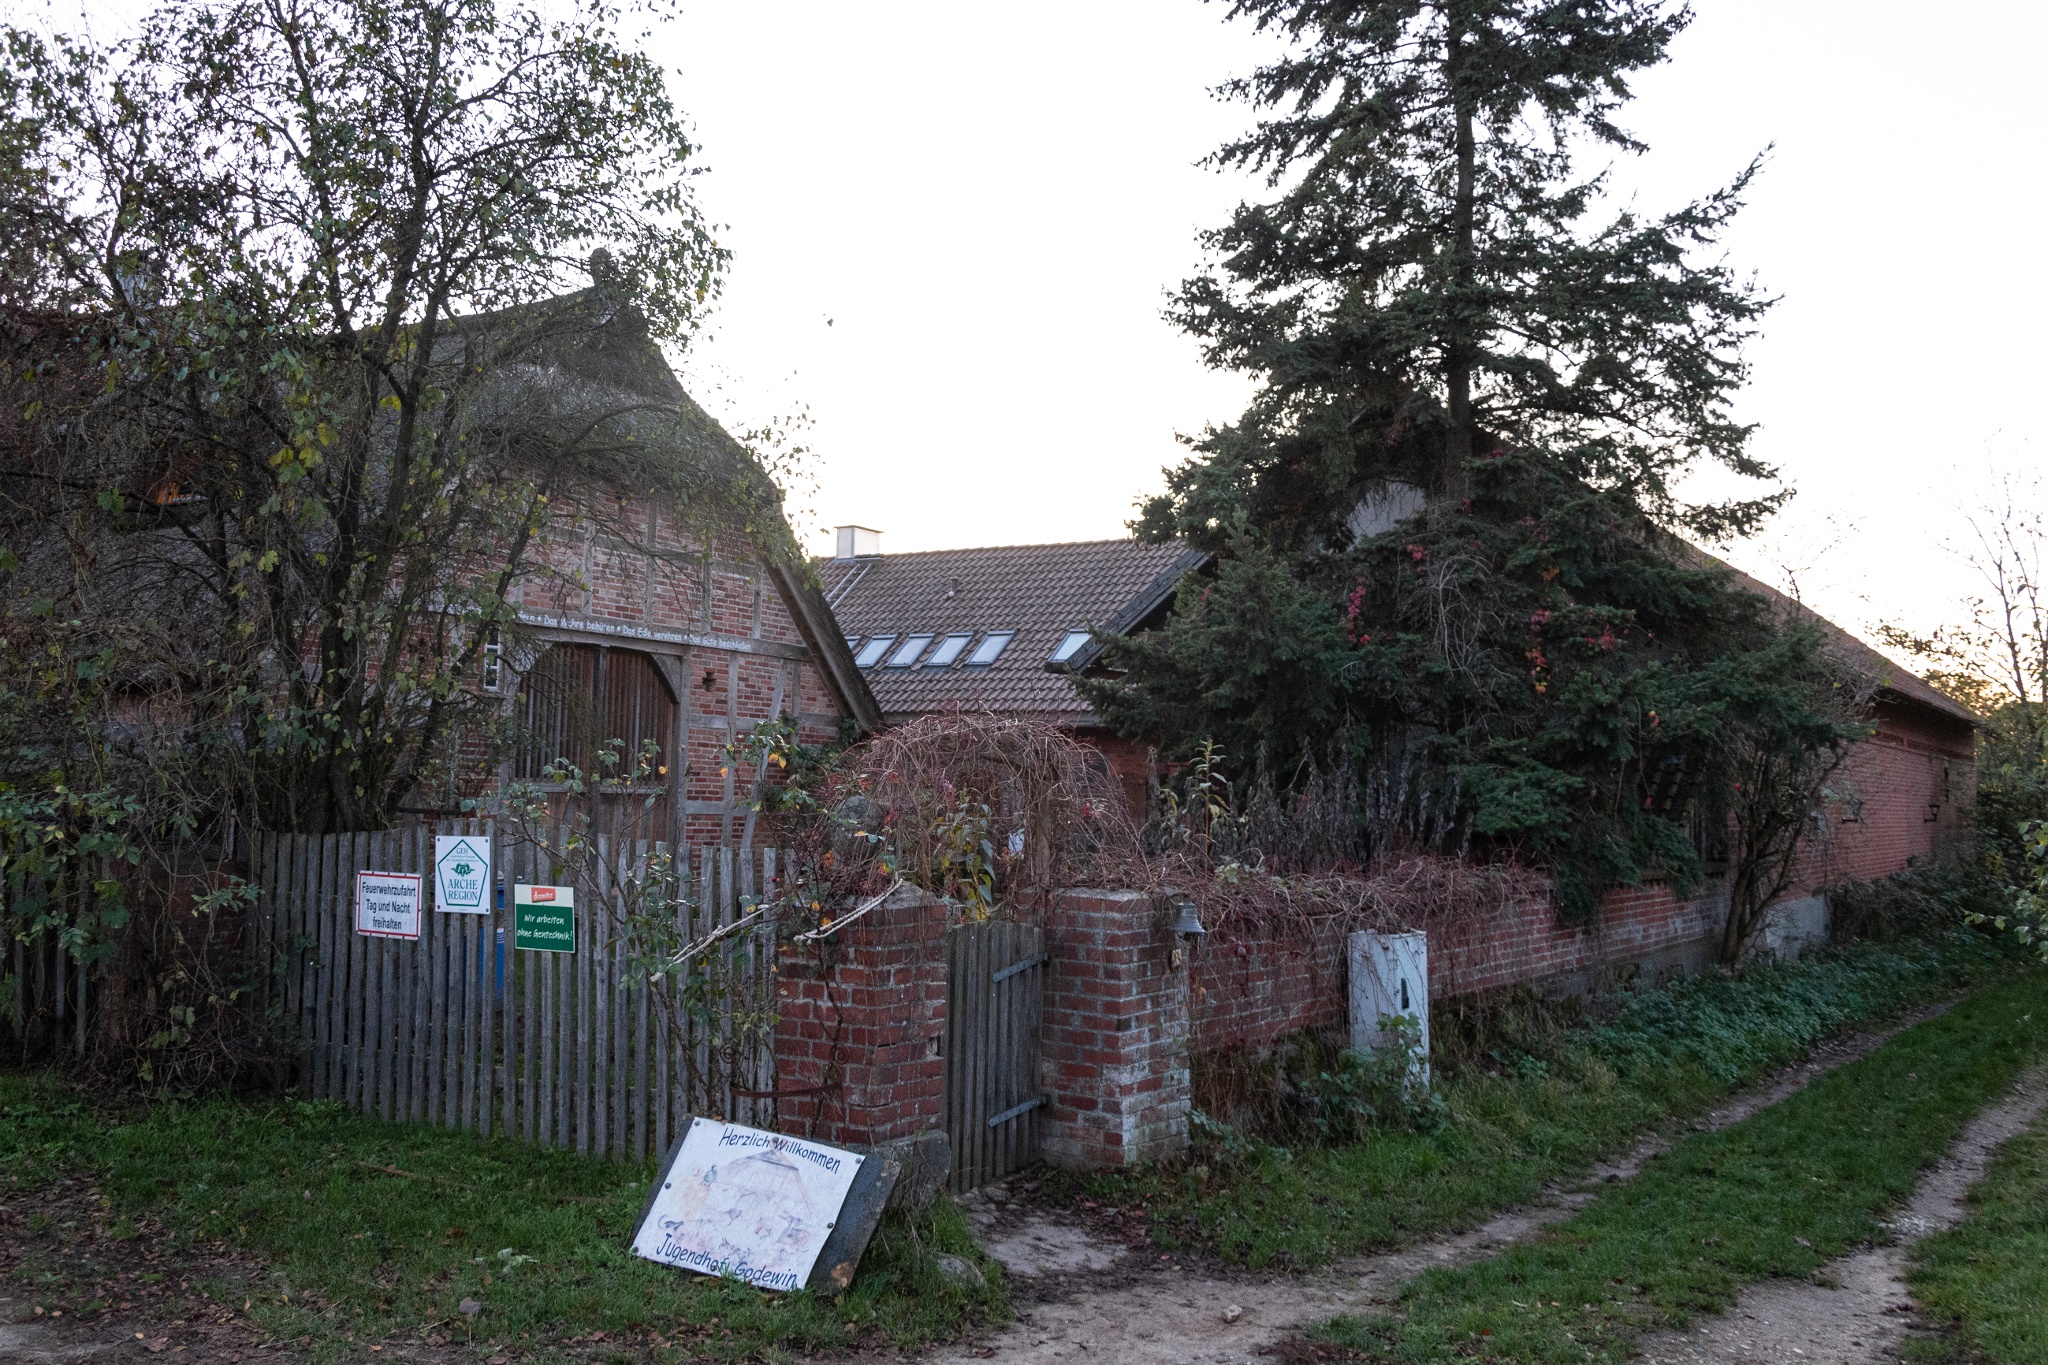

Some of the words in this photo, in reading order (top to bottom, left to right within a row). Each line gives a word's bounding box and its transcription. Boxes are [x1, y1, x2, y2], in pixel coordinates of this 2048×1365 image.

[544, 614, 558, 625] Das
[622, 625, 636, 635] Das
[637, 627, 652, 637] Edle
[362, 881, 416, 897] Feuerwehrzufahrt
[448, 890, 478, 901] REGION
[366, 899, 377, 913] Tag
[378, 901, 390, 912] und
[391, 901, 411, 914] Nacht
[372, 916, 402, 930] freihalten
[524, 913, 536, 923] Wir
[536, 914, 565, 925] arbeiten
[517, 928, 532, 938] ohne
[533, 929, 572, 940] Gentechnik!
[718, 1127, 770, 1148] Herzlich
[774, 1137, 842, 1174] Willkommen
[656, 1232, 730, 1271] Jugendhof
[734, 1261, 798, 1288] Godewin
